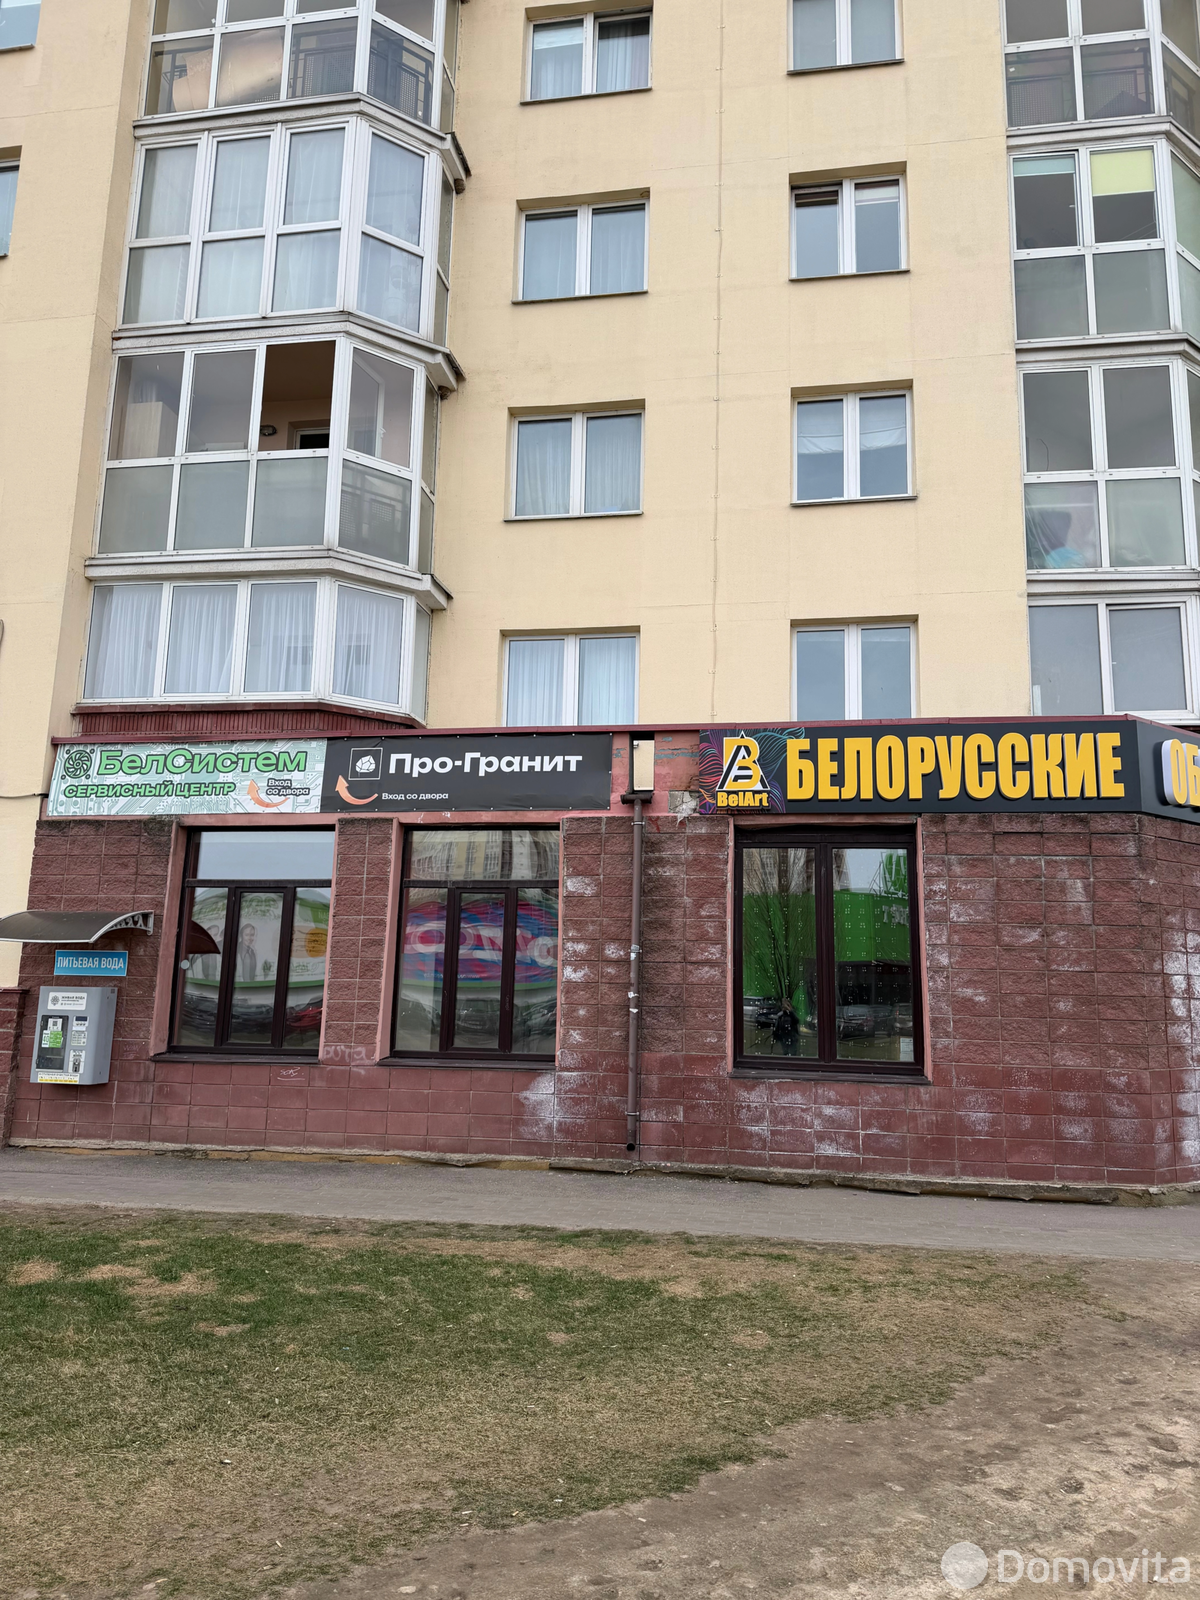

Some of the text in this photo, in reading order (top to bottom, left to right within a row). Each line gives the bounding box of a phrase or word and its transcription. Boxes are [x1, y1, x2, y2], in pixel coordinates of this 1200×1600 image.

[97, 748, 308, 775] БелСистем
[388, 752, 583, 778] Про-Гранит
[786, 732, 1126, 800] БЕЛОРУССКИЕ
[1162, 739, 1200, 807] ОБ
[64, 780, 236, 798] СЕРВИСНЫЙ ЦЕНТР
[266, 787, 310, 797] со двора
[267, 778, 291, 789] Вход
[381, 792, 405, 801] Вход
[418, 792, 449, 801] двора
[717, 791, 769, 807] BelArt
[57, 956, 124, 970] ПИТЬЕВАЯ ВОДА
